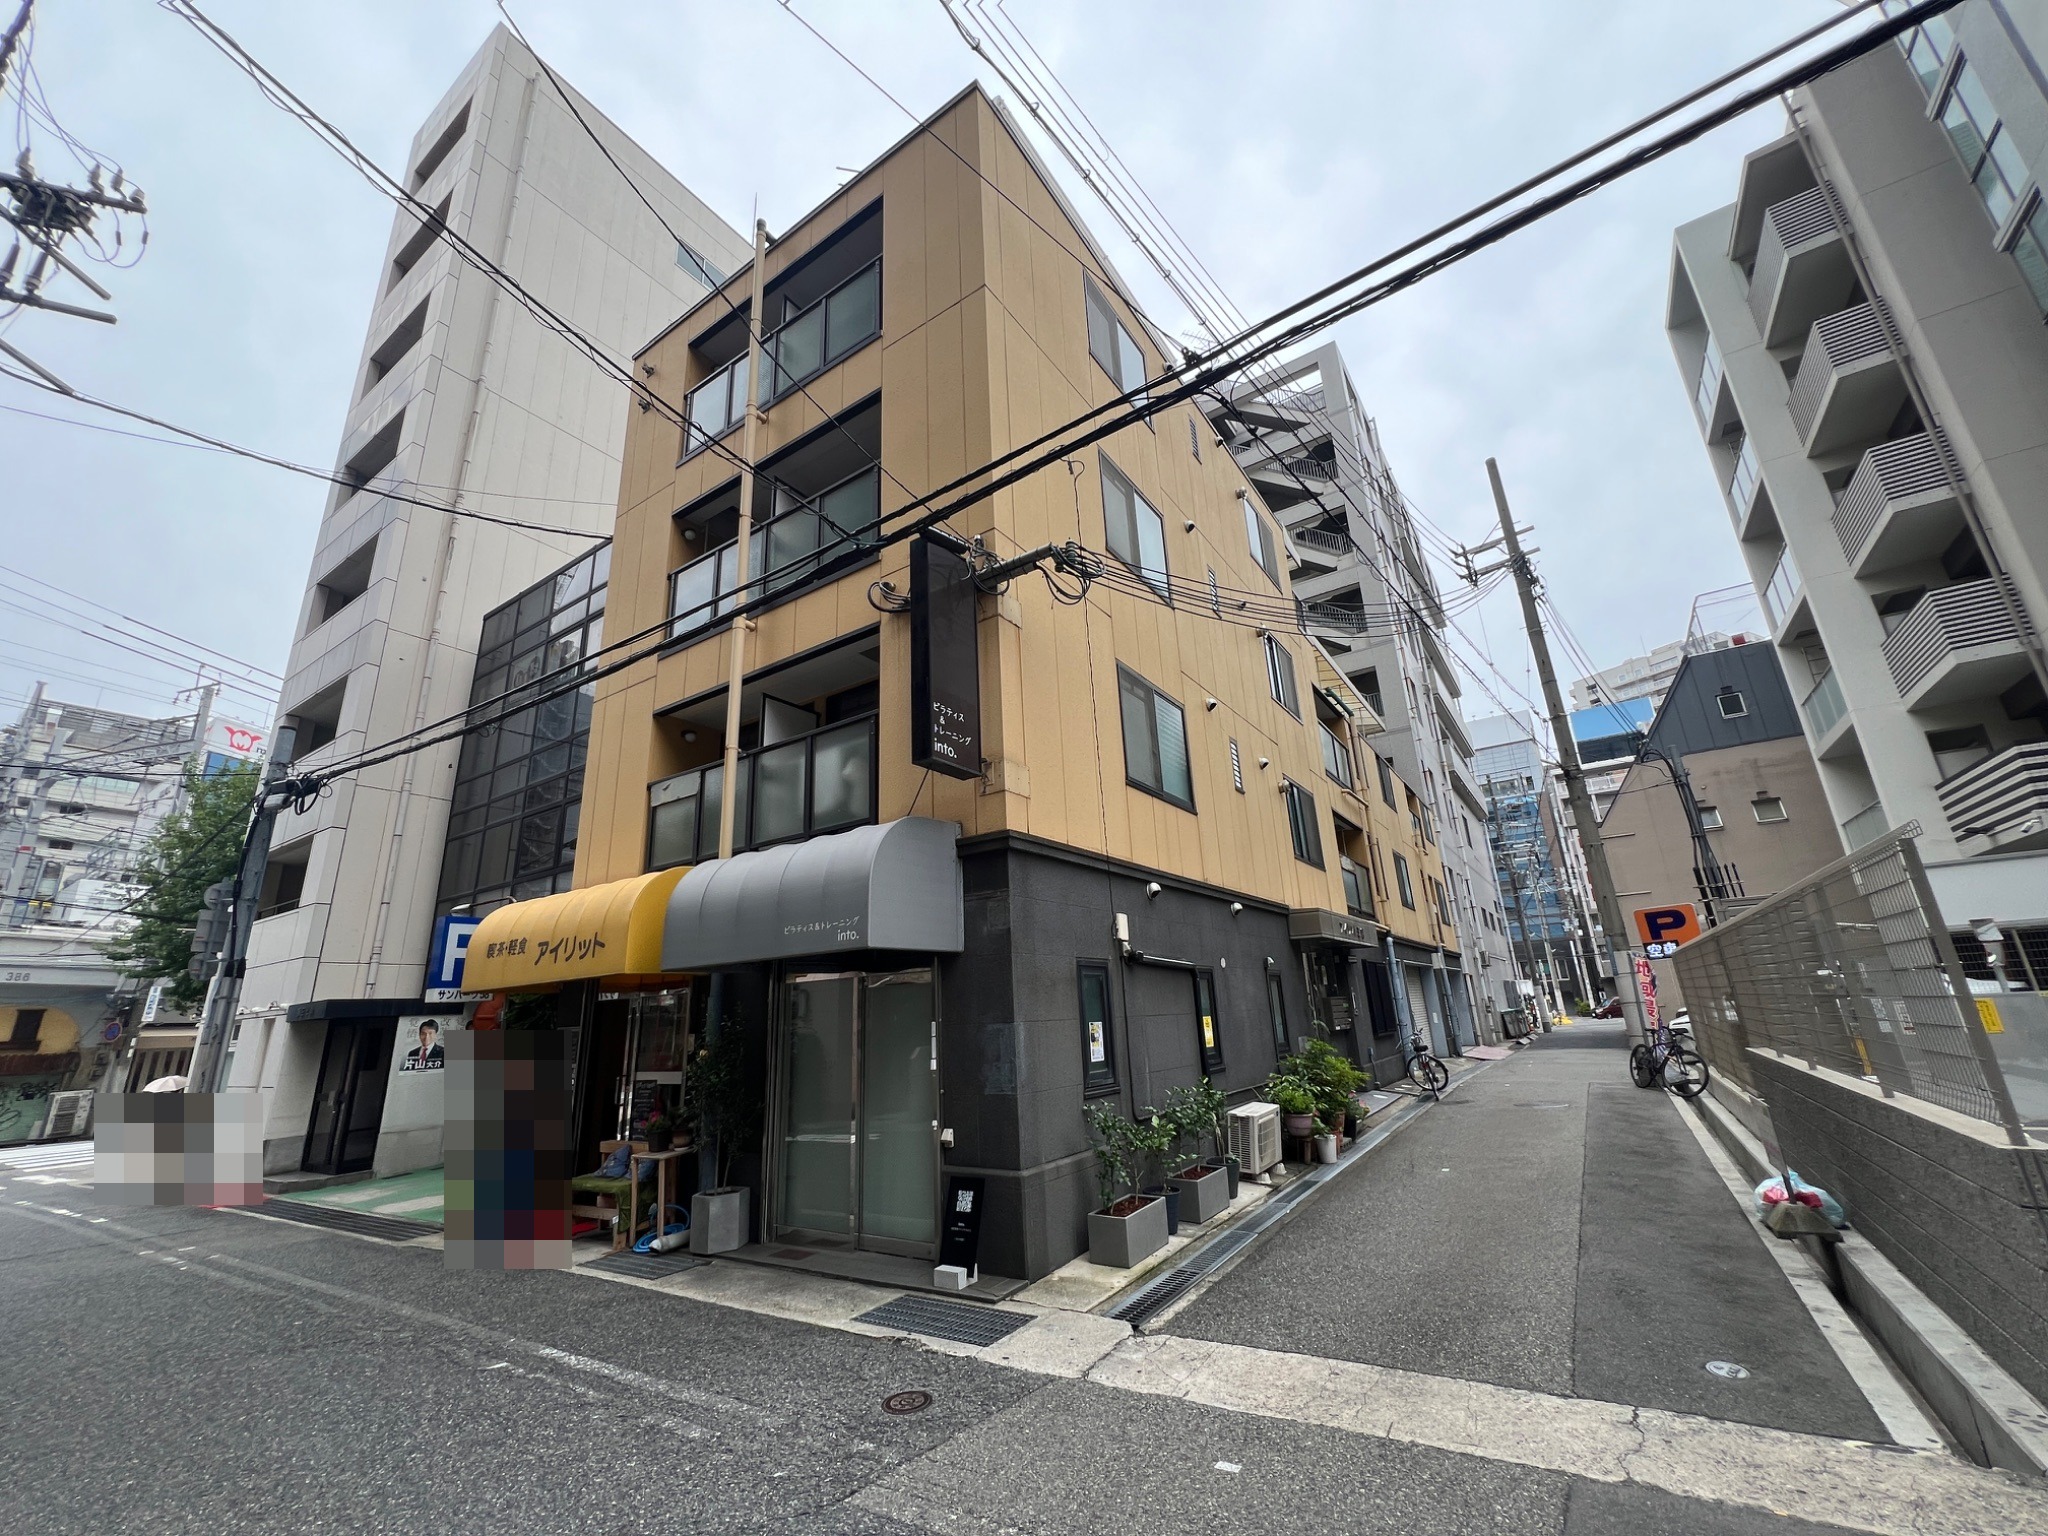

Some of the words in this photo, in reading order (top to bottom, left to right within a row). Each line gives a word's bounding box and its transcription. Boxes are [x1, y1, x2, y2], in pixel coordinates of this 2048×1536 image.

[933, 701, 965, 722] ピラティス
[940, 715, 946, 725] &
[934, 723, 972, 746] トレーニング
[934, 737, 958, 758] into.
[837, 929, 860, 941] into.
[1644, 909, 1687, 941] P
[534, 932, 606, 966] アイリット
[5, 972, 31, 982] 386
